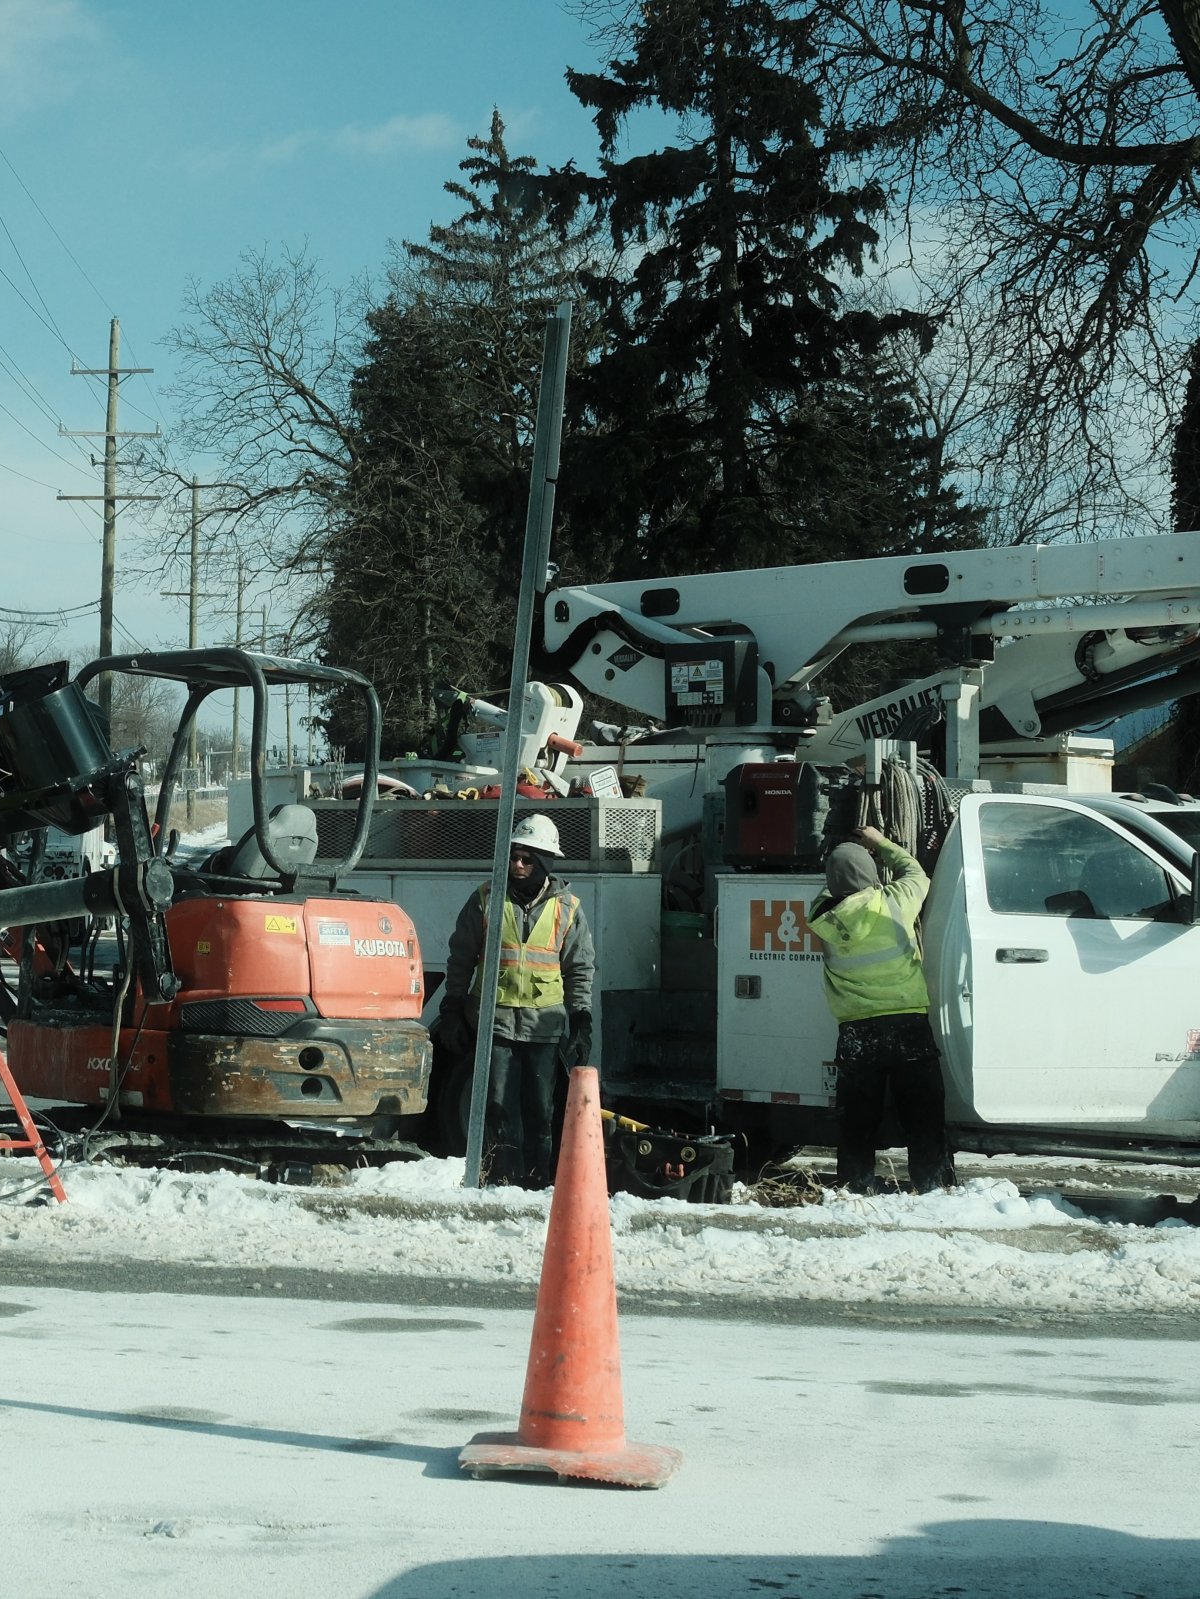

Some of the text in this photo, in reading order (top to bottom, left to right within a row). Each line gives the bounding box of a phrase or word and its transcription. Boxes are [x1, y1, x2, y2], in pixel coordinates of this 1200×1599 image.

[321, 926, 347, 935] SAFETY
[354, 939, 407, 957] KUBOTA
[749, 952, 826, 962] ELECTRIC COMPANY
